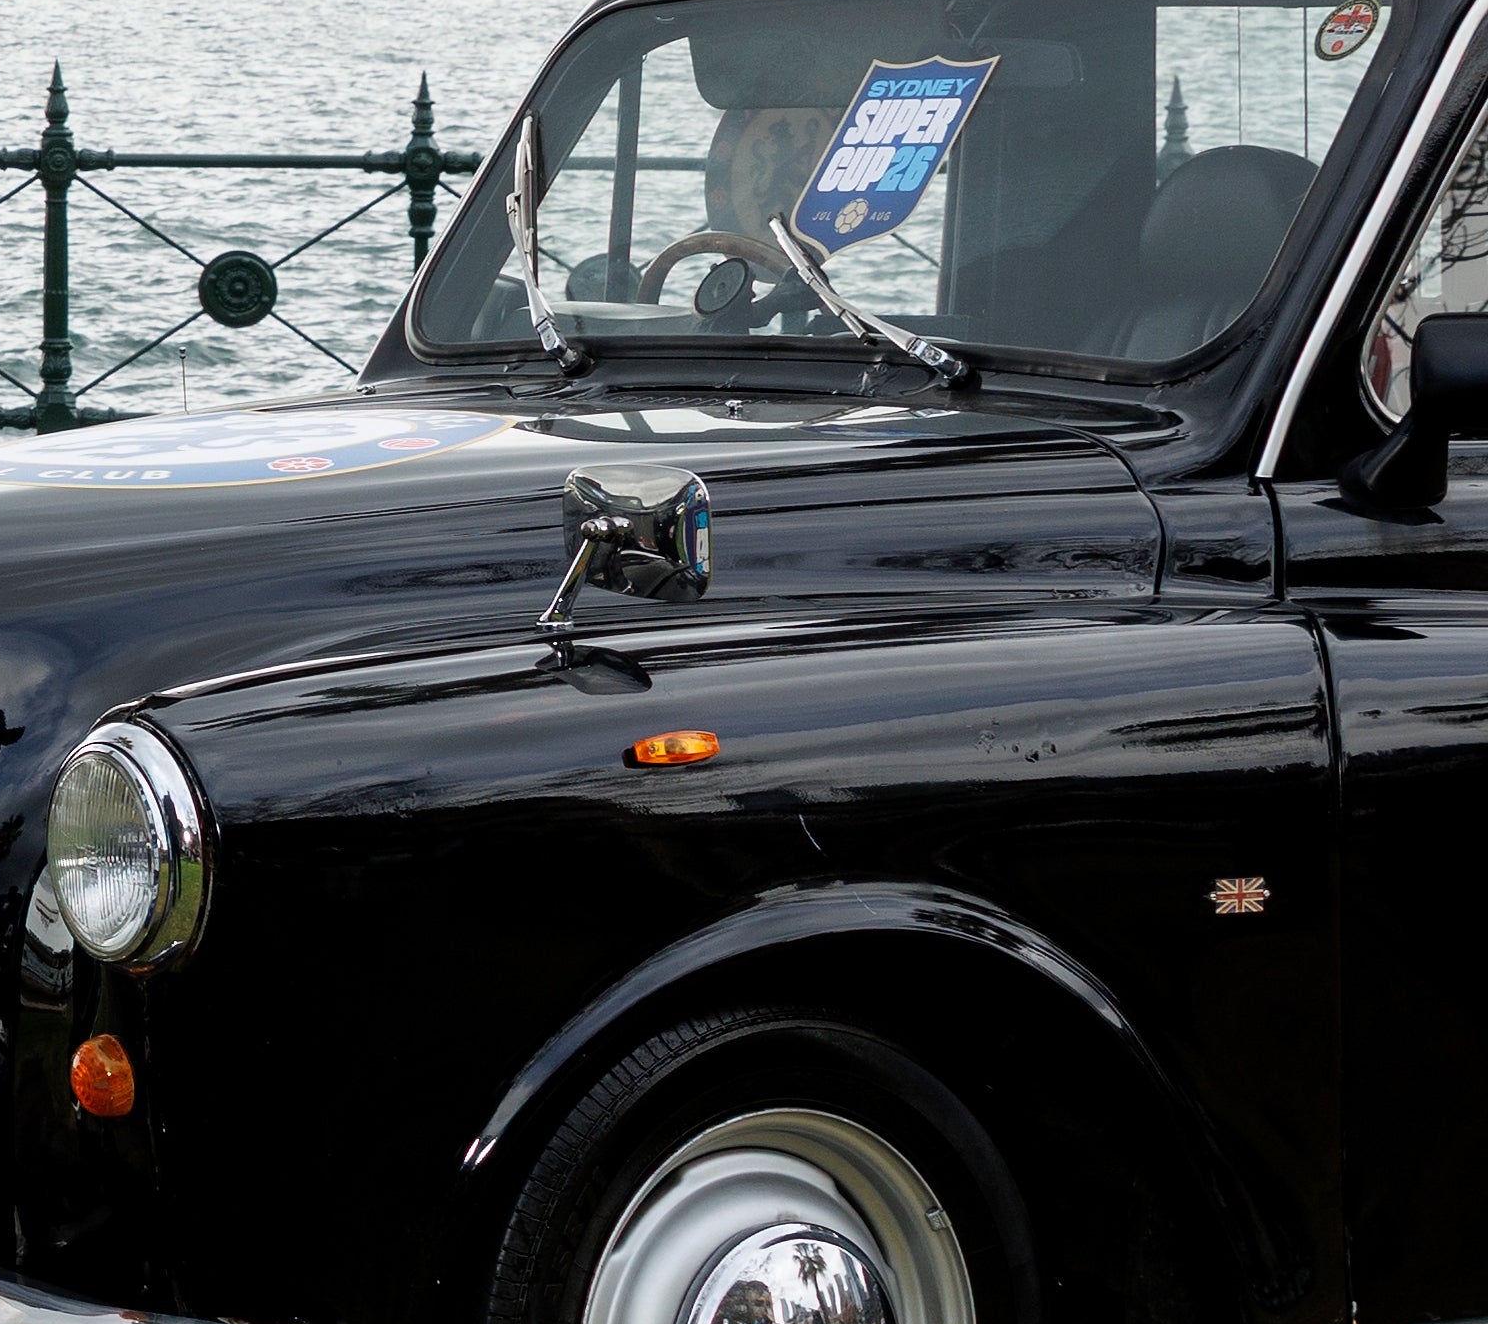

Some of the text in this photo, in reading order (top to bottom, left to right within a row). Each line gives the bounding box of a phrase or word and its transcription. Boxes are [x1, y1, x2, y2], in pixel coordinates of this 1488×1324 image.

[867, 77, 976, 98] SYDNEY
[842, 98, 962, 145] SUPER
[816, 146, 937, 192] CUP26
[812, 211, 892, 222] JUL AUG
[37, 469, 172, 480] CLUB
